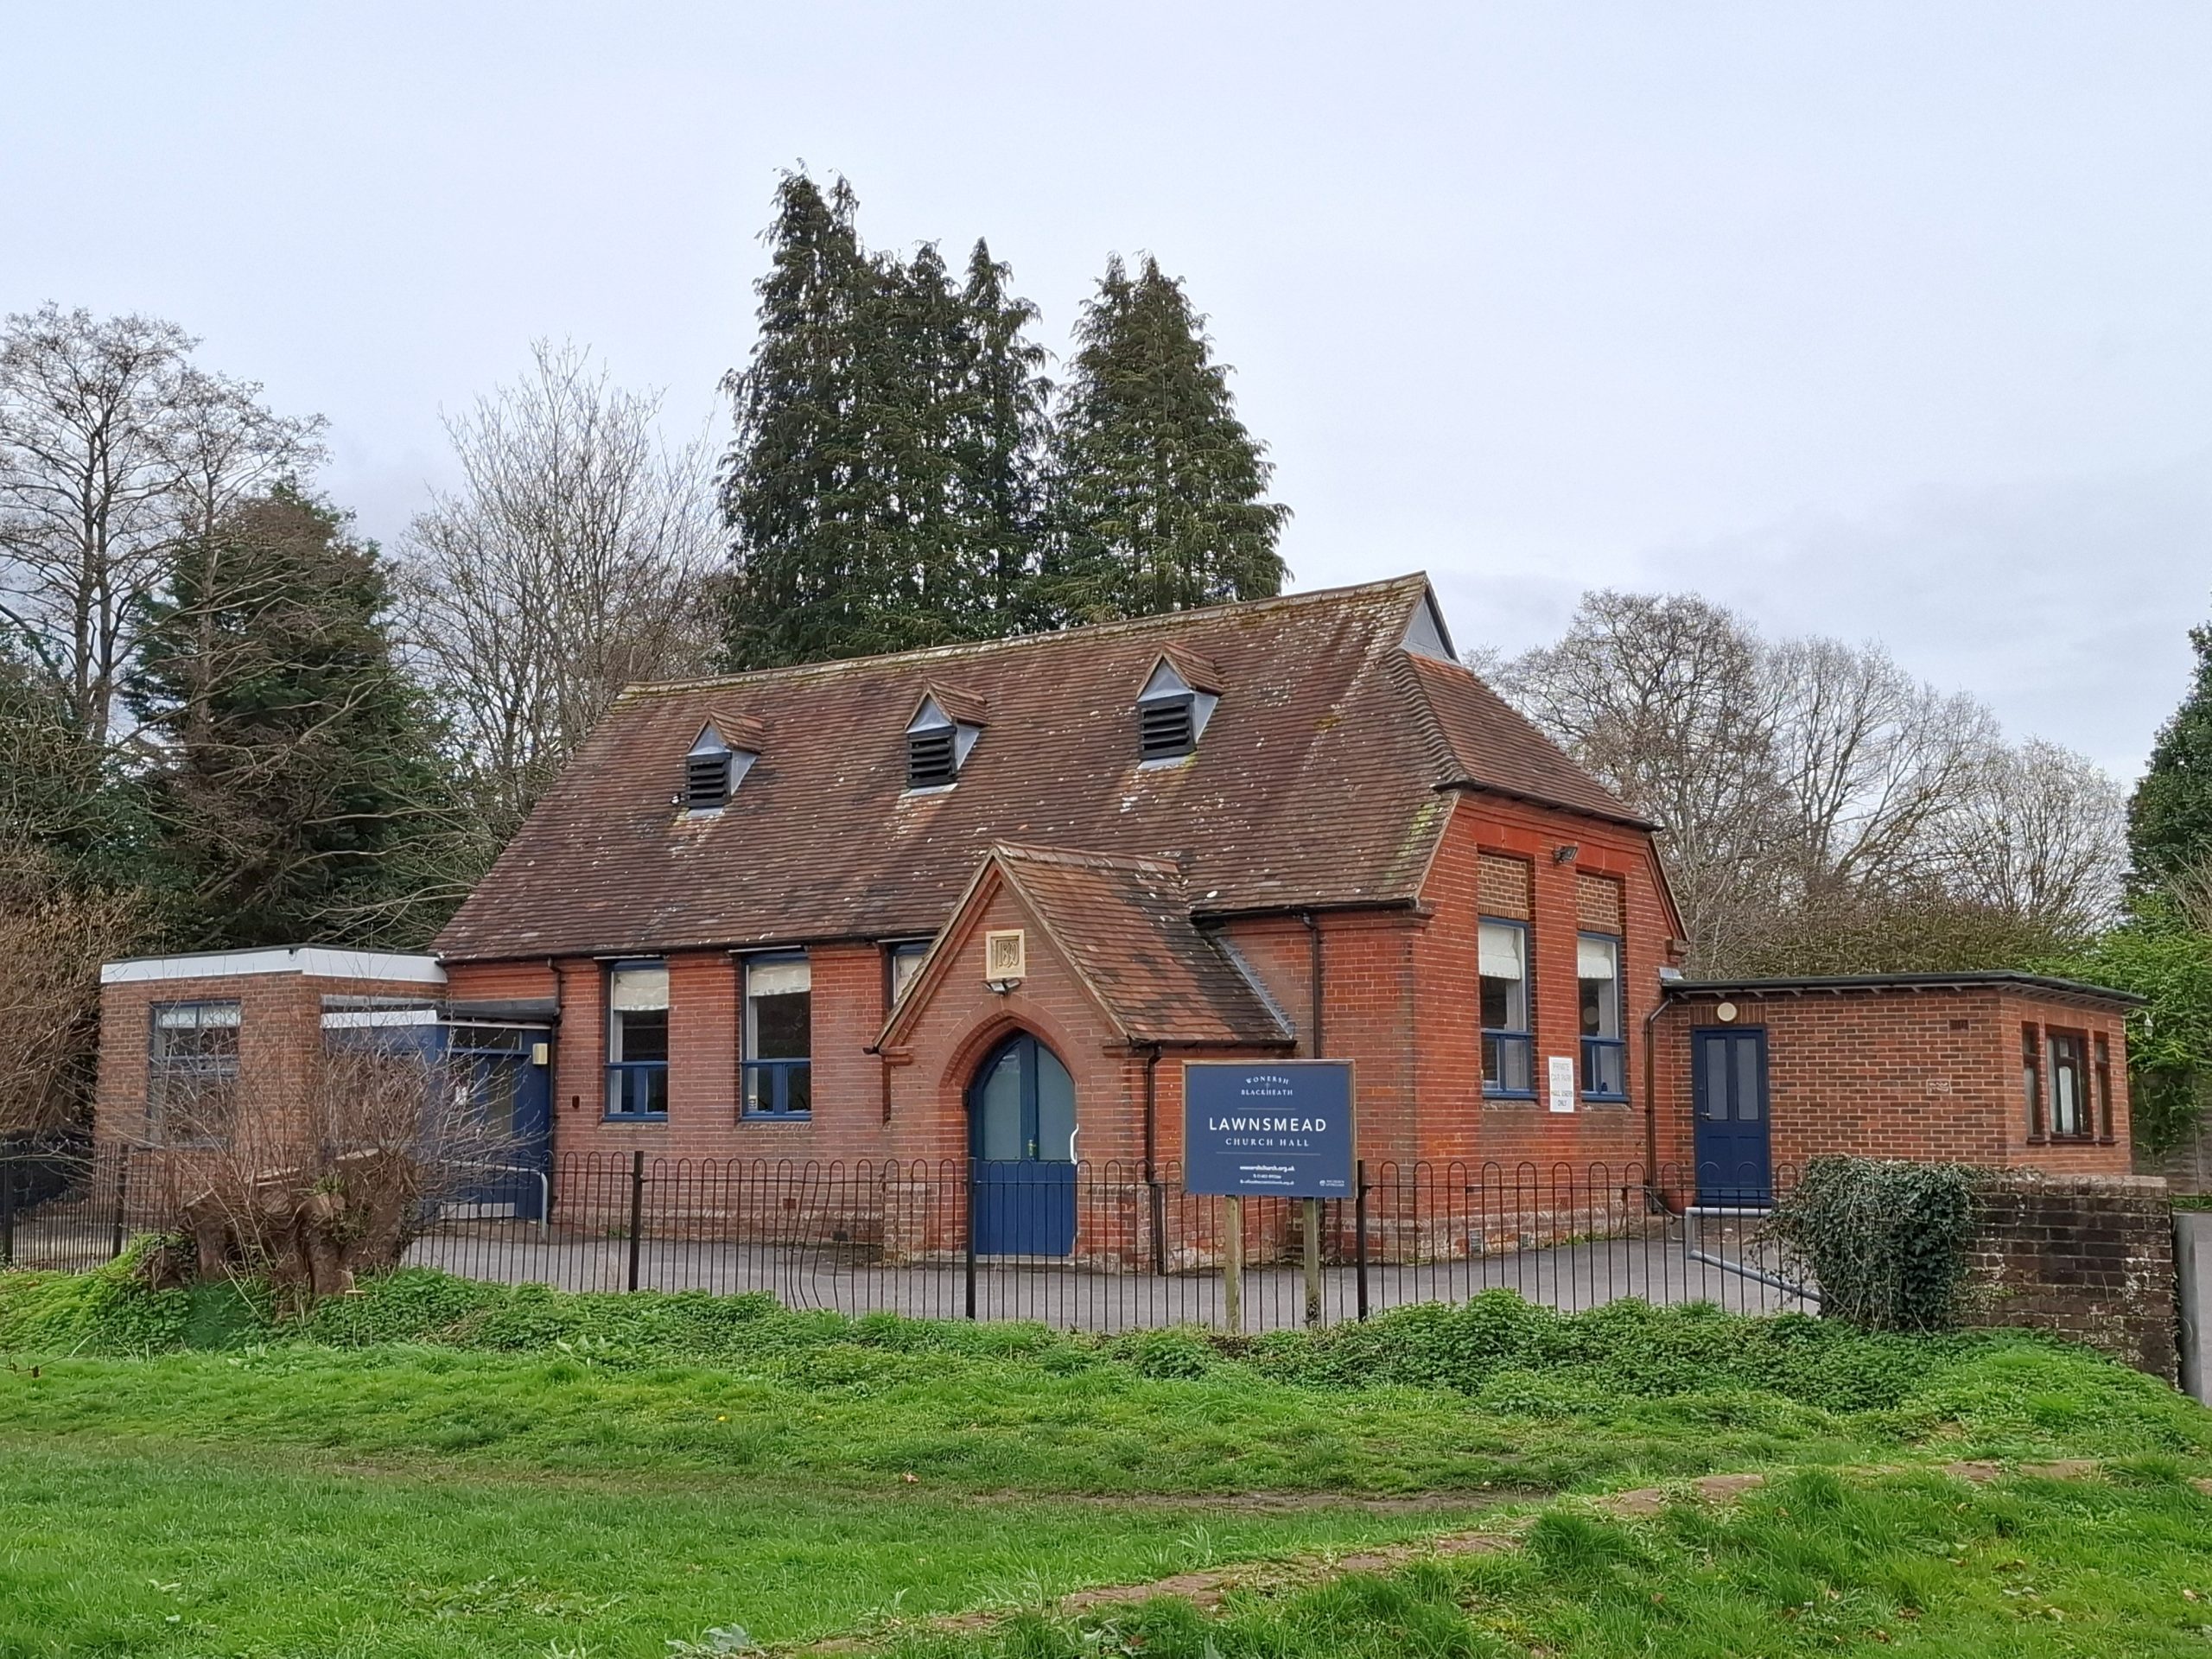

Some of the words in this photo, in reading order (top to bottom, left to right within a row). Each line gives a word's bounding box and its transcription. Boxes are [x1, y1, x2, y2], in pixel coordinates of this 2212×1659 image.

[1246, 1076, 1288, 1084] WONERSH
[1209, 1117, 1326, 1131] LAWNSMEAD
[1225, 1137, 1273, 1147] CHURCH
[1280, 1138, 1309, 1147] HALL
